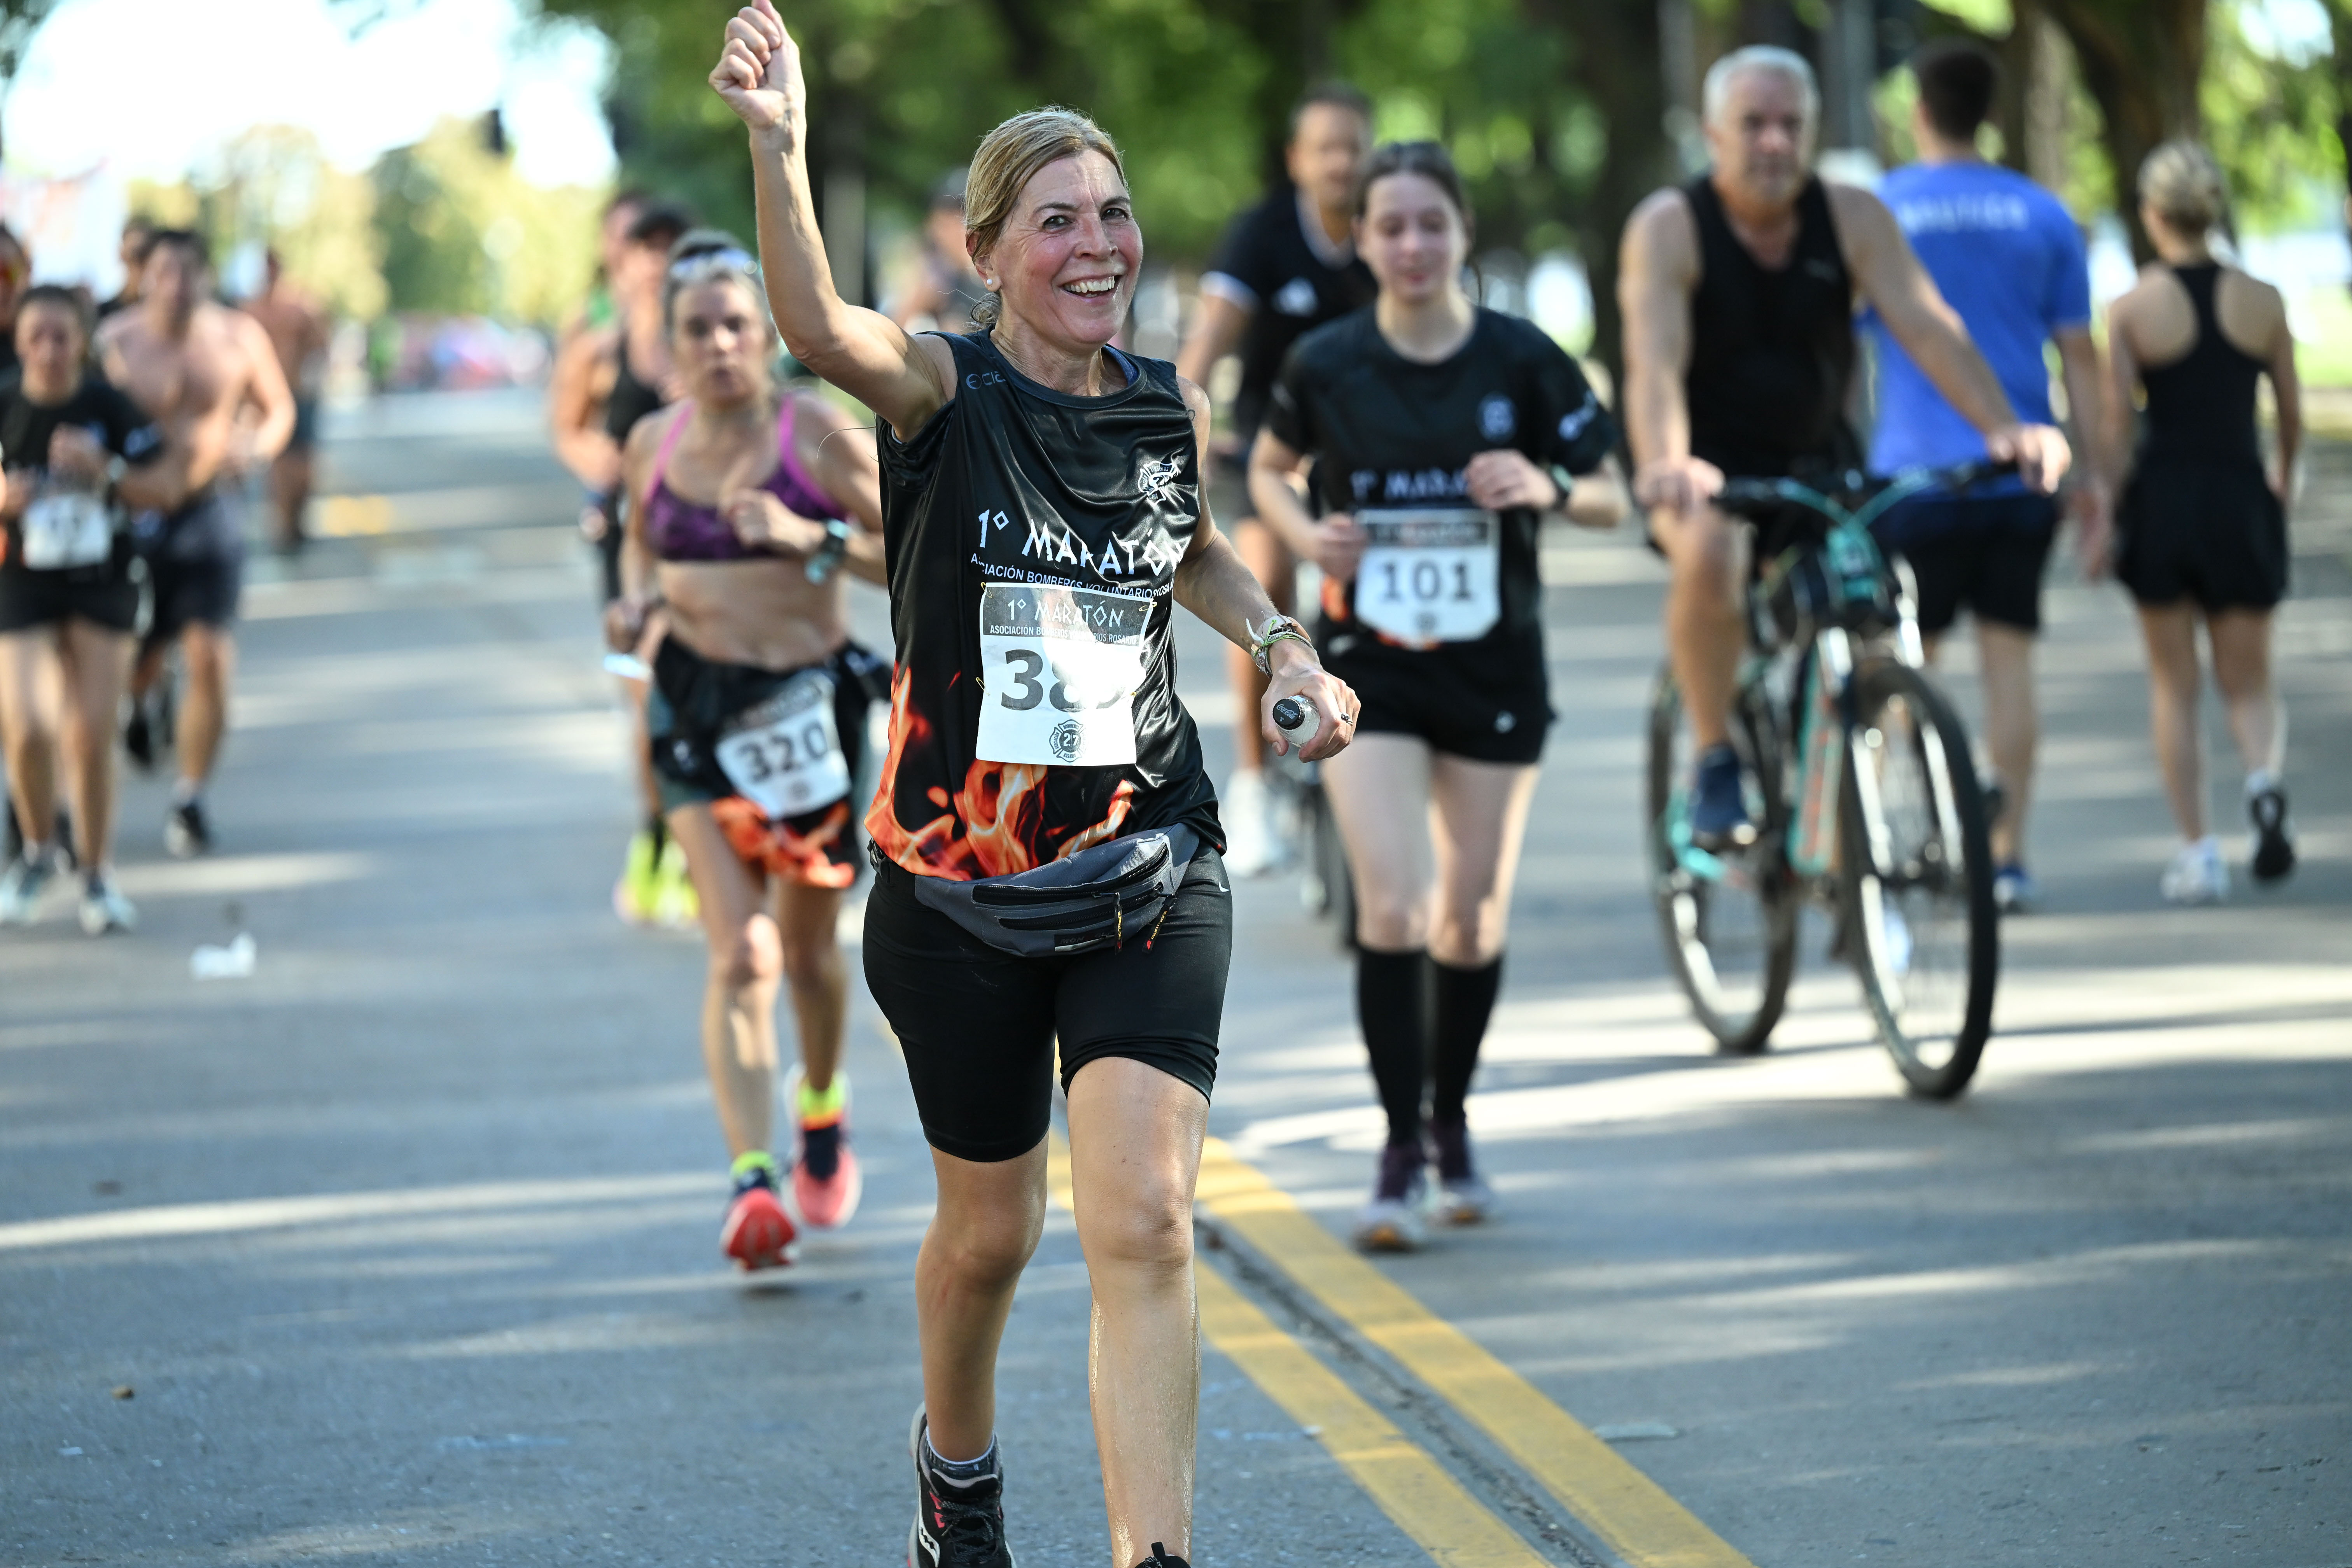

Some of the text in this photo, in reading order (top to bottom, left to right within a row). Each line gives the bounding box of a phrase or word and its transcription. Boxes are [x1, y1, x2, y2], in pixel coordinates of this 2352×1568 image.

[971, 553, 1024, 581] AIACIÓN
[1380, 559, 1474, 601] 101
[1034, 599, 1124, 628] MARATÓN
[990, 624, 1034, 635] ASOCIACIÓN
[1036, 626, 1068, 639] BOMBEROS
[1108, 633, 1138, 644] ROSARIO
[1001, 649, 1126, 712] 38
[737, 720, 829, 784] 320
[1063, 732, 1079, 747] 27
